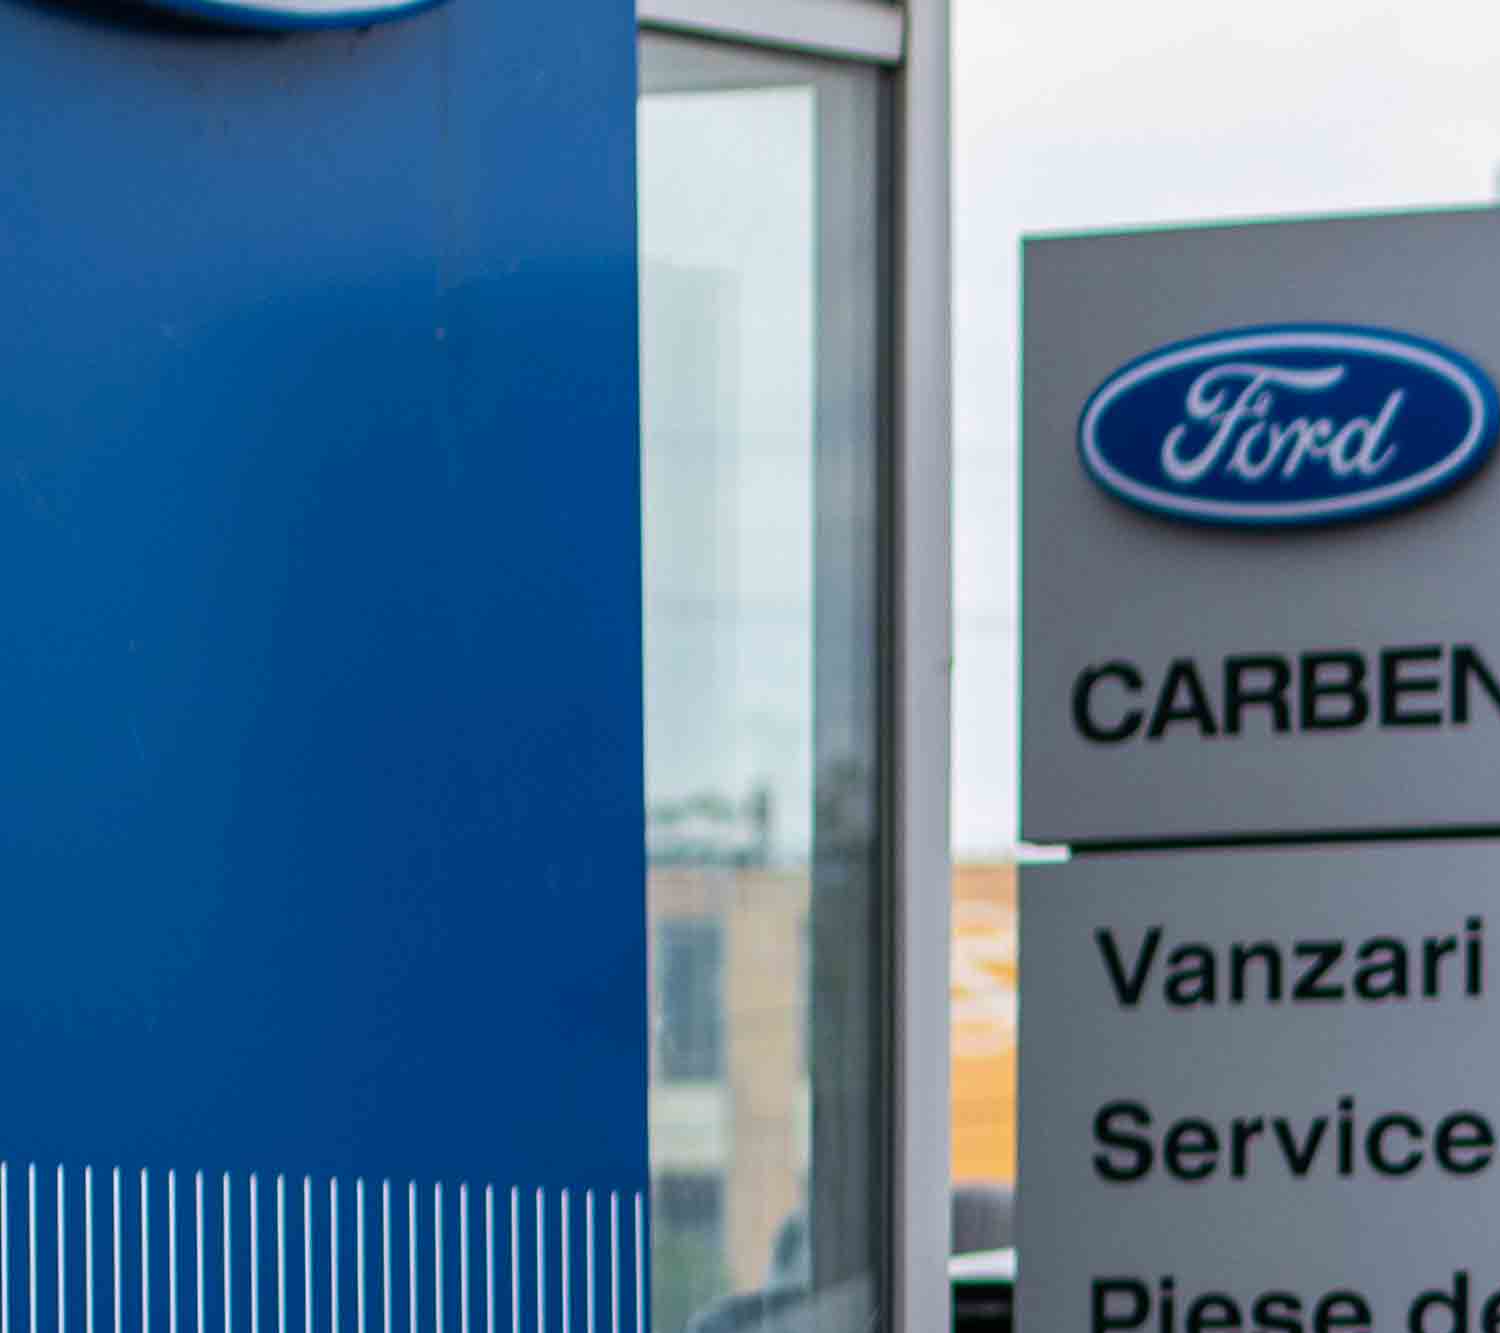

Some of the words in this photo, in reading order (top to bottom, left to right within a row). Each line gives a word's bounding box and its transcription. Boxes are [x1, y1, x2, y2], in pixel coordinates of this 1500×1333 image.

[1160, 361, 1406, 483] Ford
[1094, 917, 1485, 1007] Vanzari
[1091, 1097, 1497, 1183] Service
